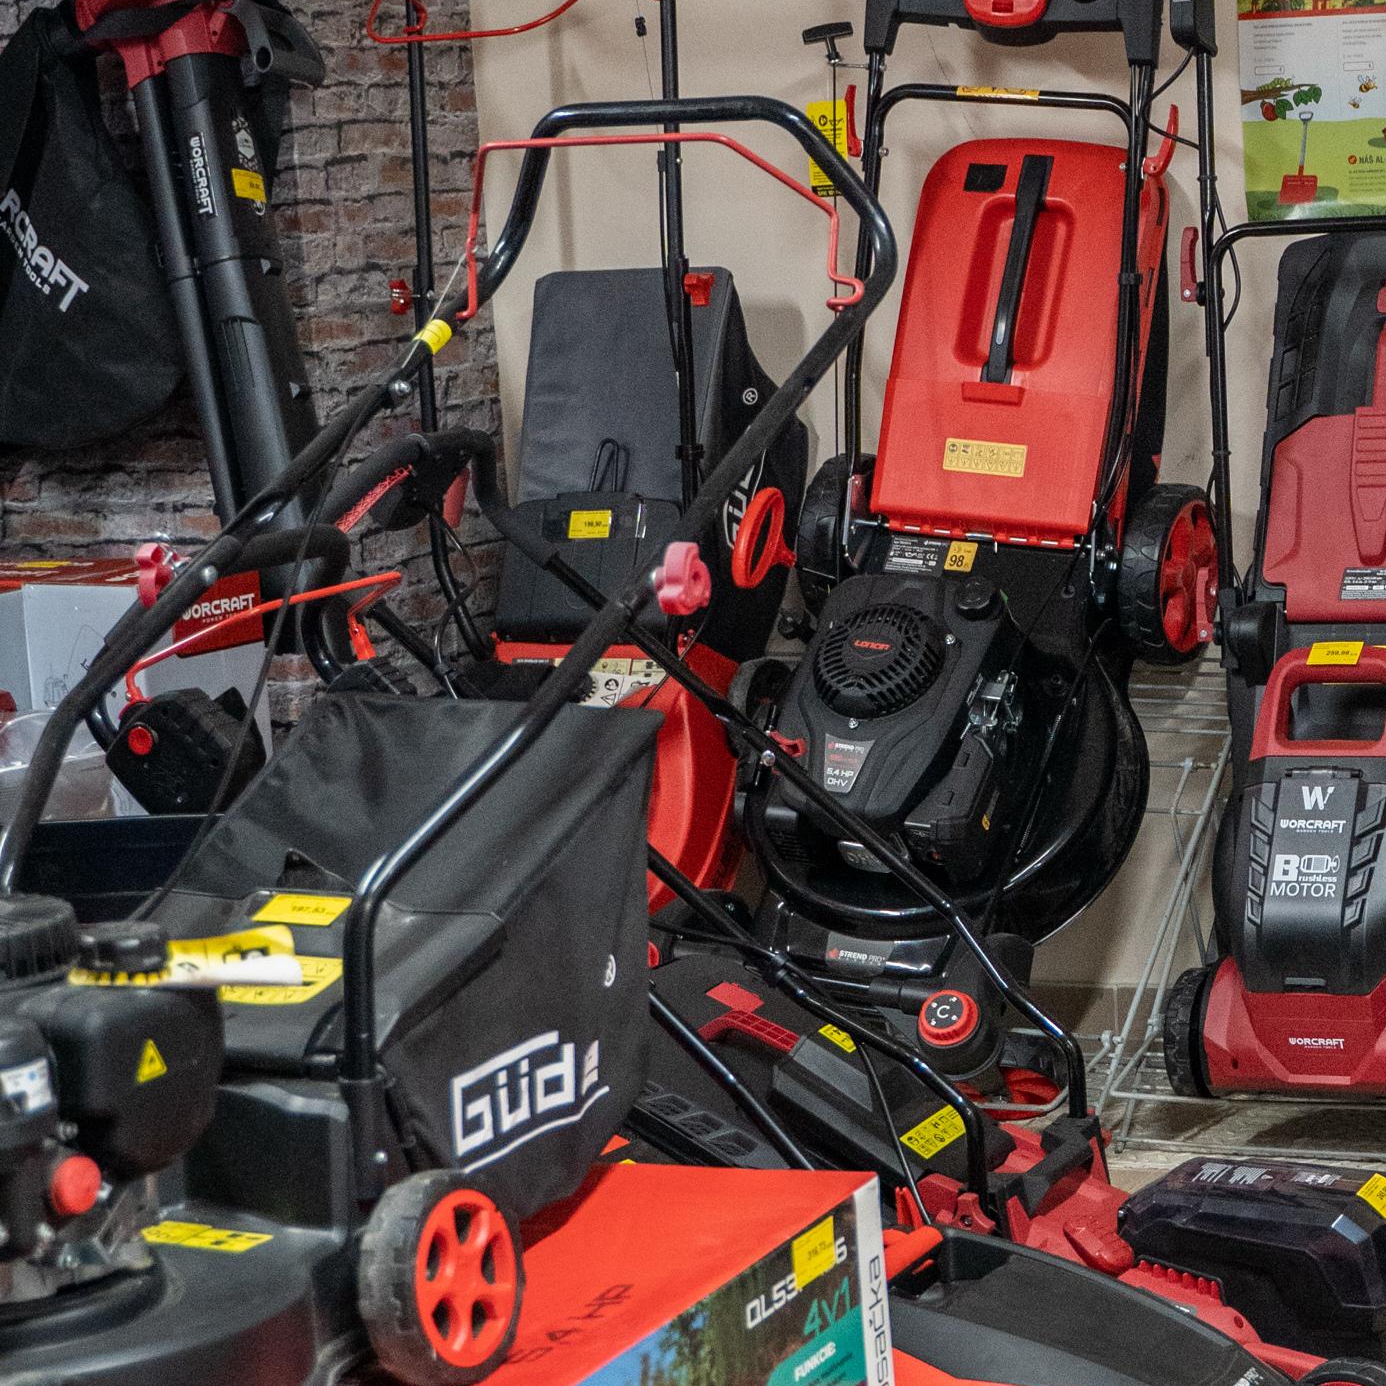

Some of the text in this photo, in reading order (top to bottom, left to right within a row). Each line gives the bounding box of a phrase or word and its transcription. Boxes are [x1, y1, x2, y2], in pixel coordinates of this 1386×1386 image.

[190, 135, 214, 215] WORCRAFT
[949, 554, 965, 567] 98
[1279, 819, 1347, 833] WORCRAFT
[1270, 882, 1336, 897] MOTOR
[839, 950, 867, 961] STREND
[1288, 1037, 1345, 1050] WORCRAFT
